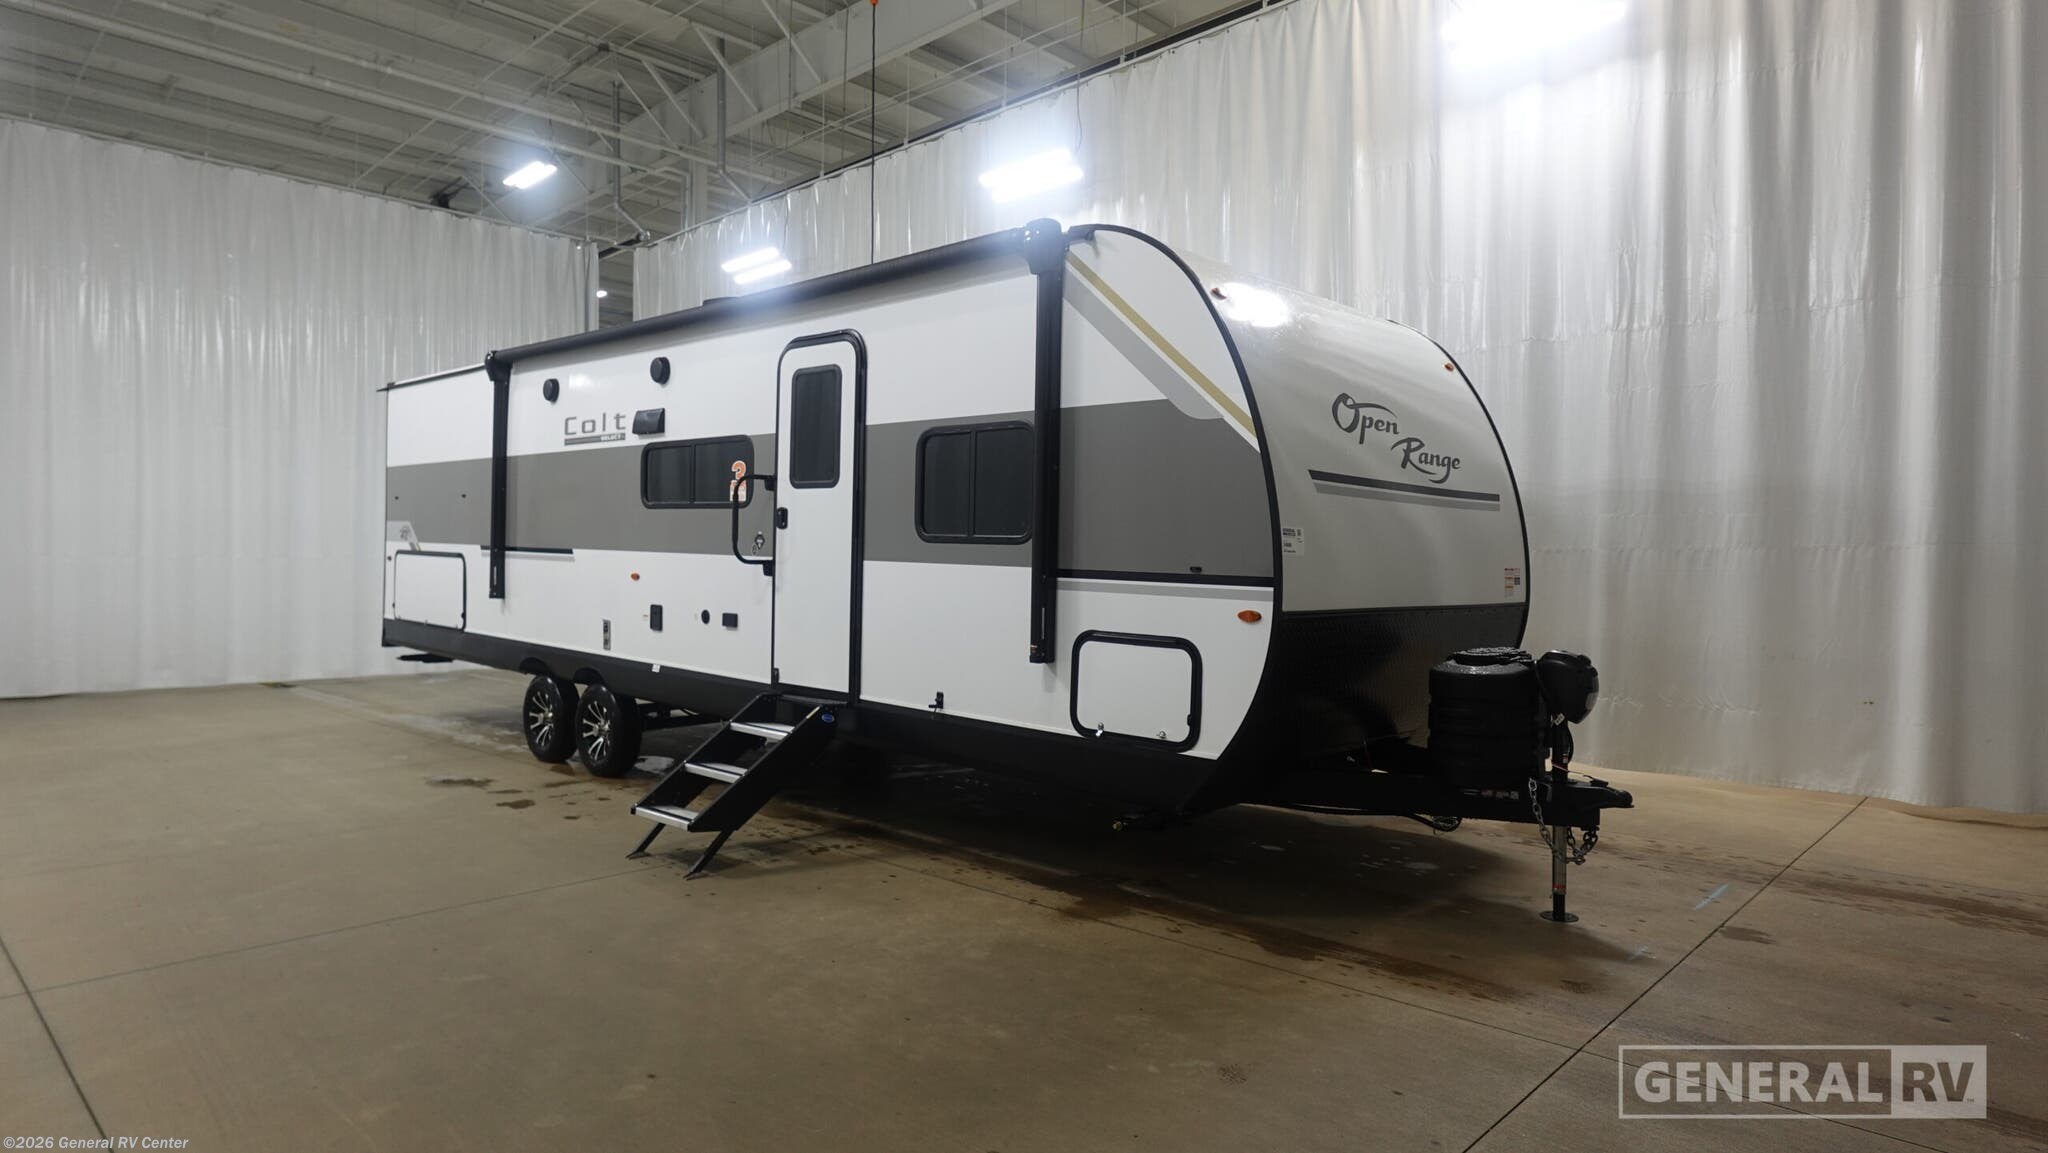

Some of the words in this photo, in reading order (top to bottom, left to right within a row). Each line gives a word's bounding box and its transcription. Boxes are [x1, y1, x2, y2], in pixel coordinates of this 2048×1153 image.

[564, 412, 626, 435] Colt
[1332, 392, 1400, 445] Open
[1390, 437, 1461, 484] Range
